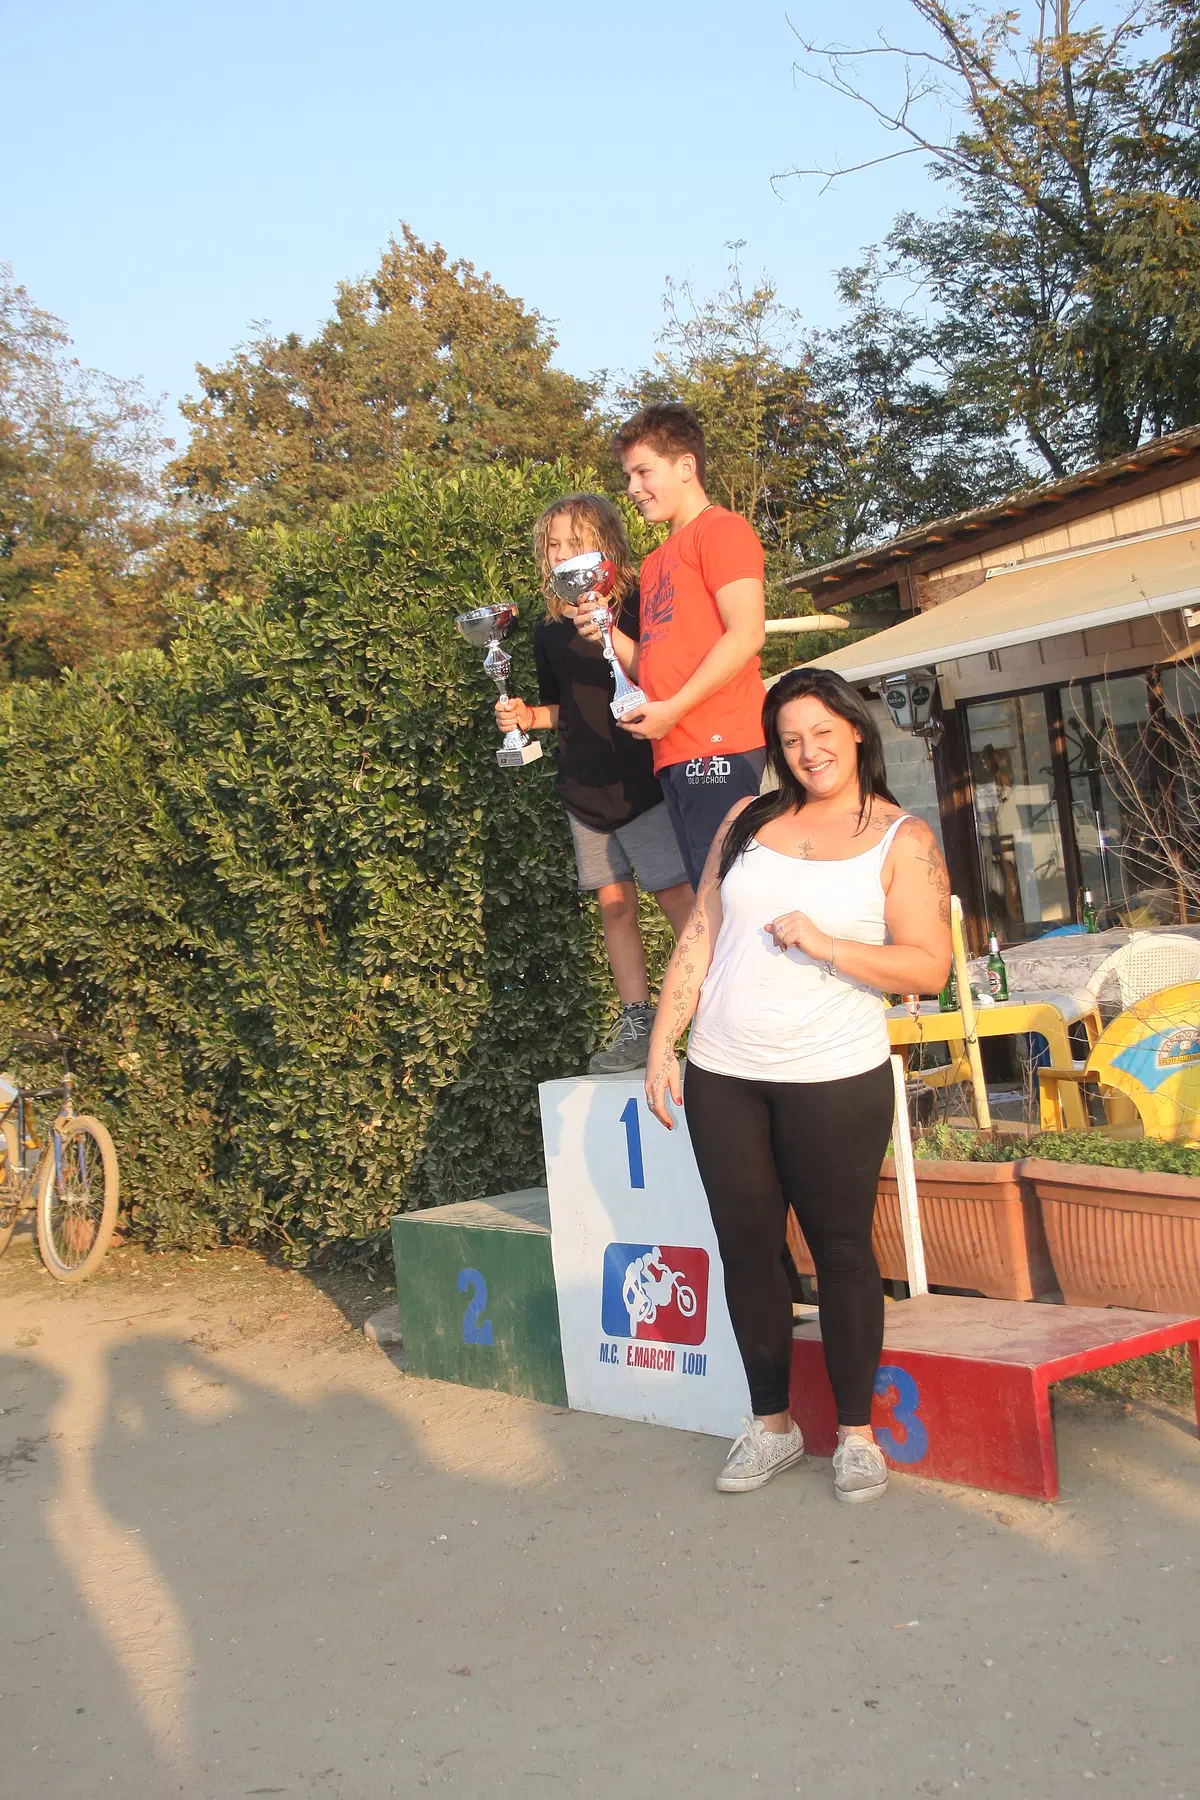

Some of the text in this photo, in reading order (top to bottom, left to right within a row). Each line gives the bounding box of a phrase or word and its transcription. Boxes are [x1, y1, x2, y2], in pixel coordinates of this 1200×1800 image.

[702, 776, 727, 784] SCHOOL
[618, 1097, 645, 1189] 1
[457, 1268, 494, 1346] 2
[599, 1342, 707, 1376] M.C. E.MARCHI LODI
[873, 1365, 929, 1465] 3
